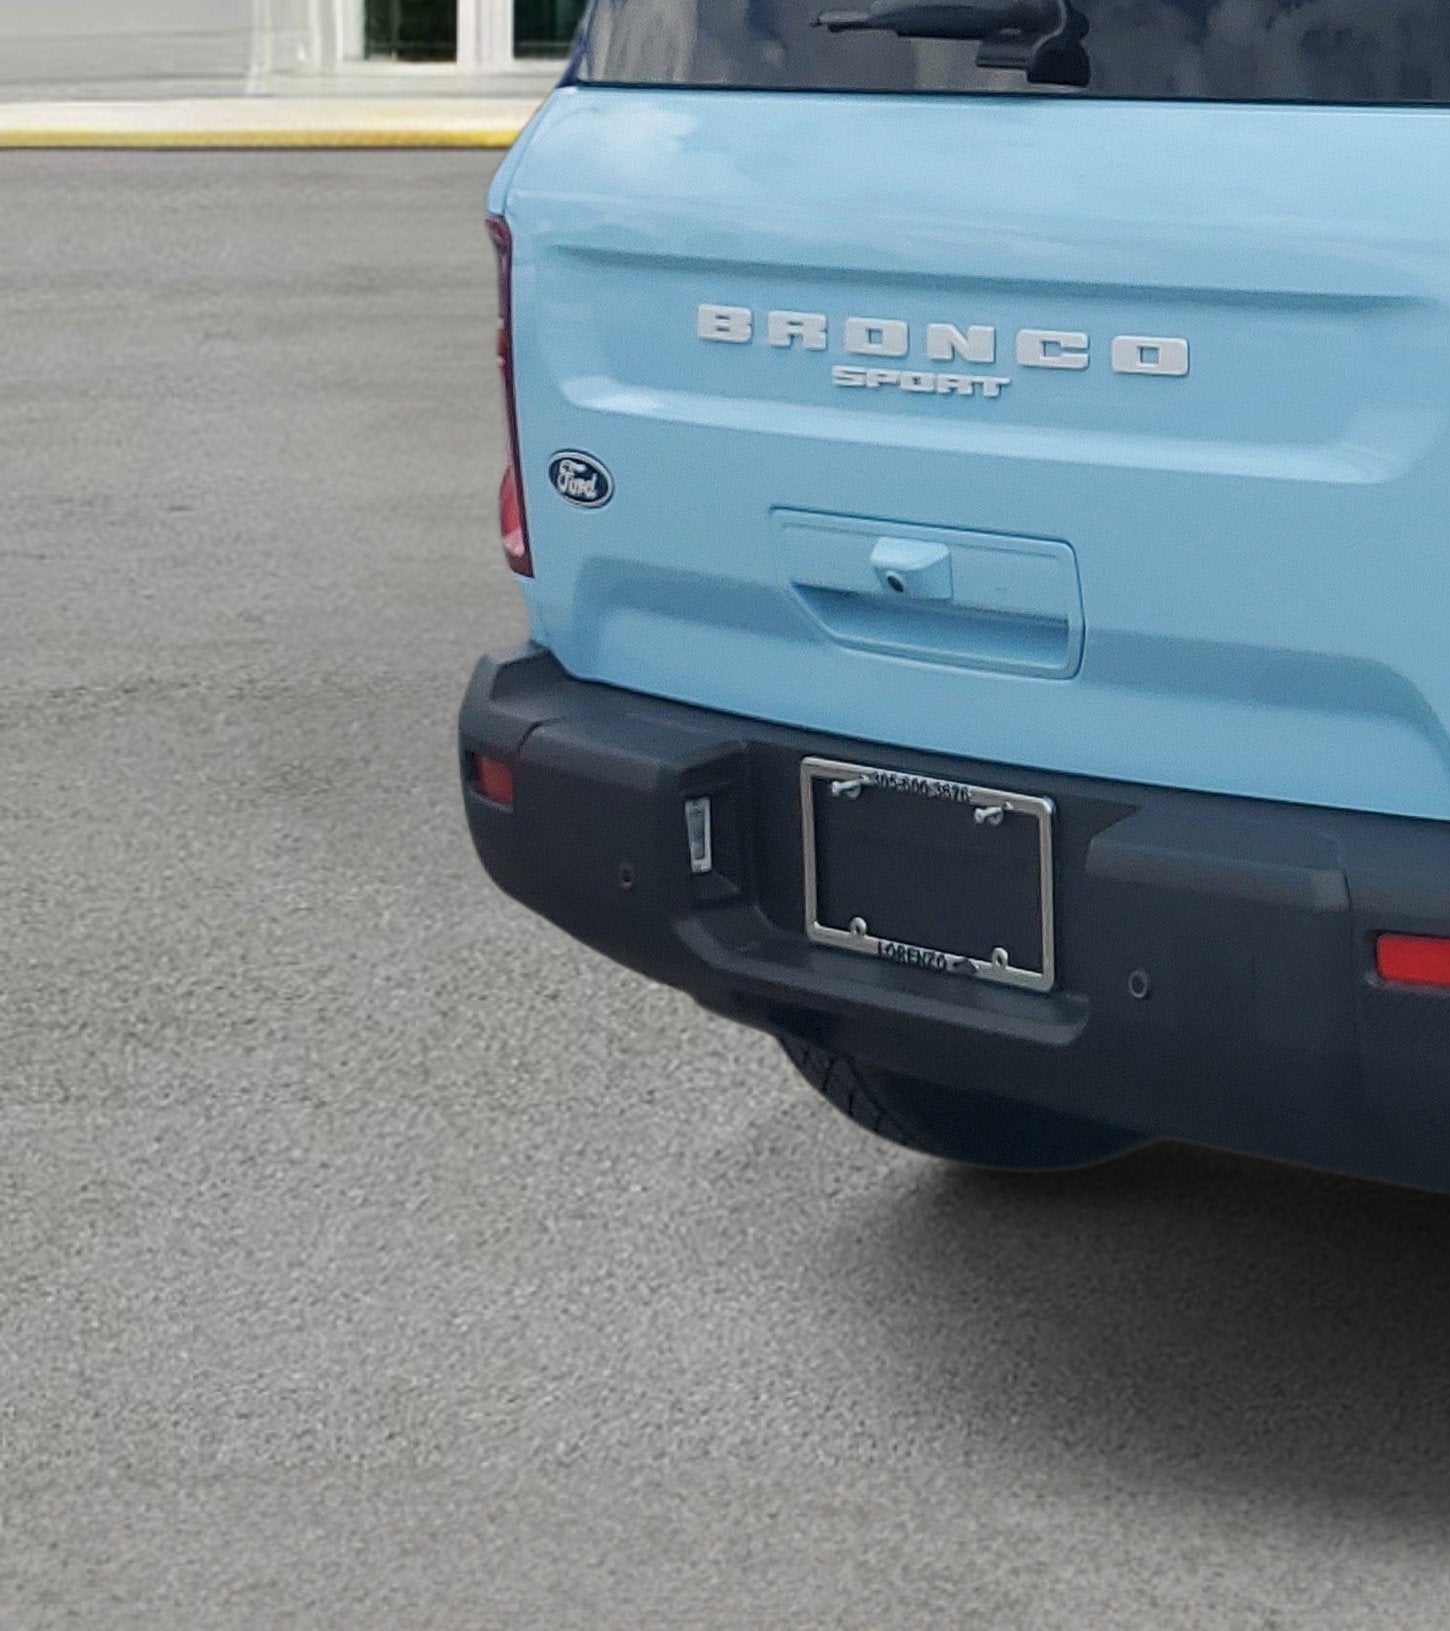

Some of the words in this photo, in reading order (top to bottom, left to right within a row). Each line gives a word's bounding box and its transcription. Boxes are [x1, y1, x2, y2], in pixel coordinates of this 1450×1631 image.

[698, 303, 1190, 376] BRONCO
[831, 365, 1011, 397] SPORT
[557, 459, 598, 499] Ford
[877, 940, 947, 971] LORENZO
